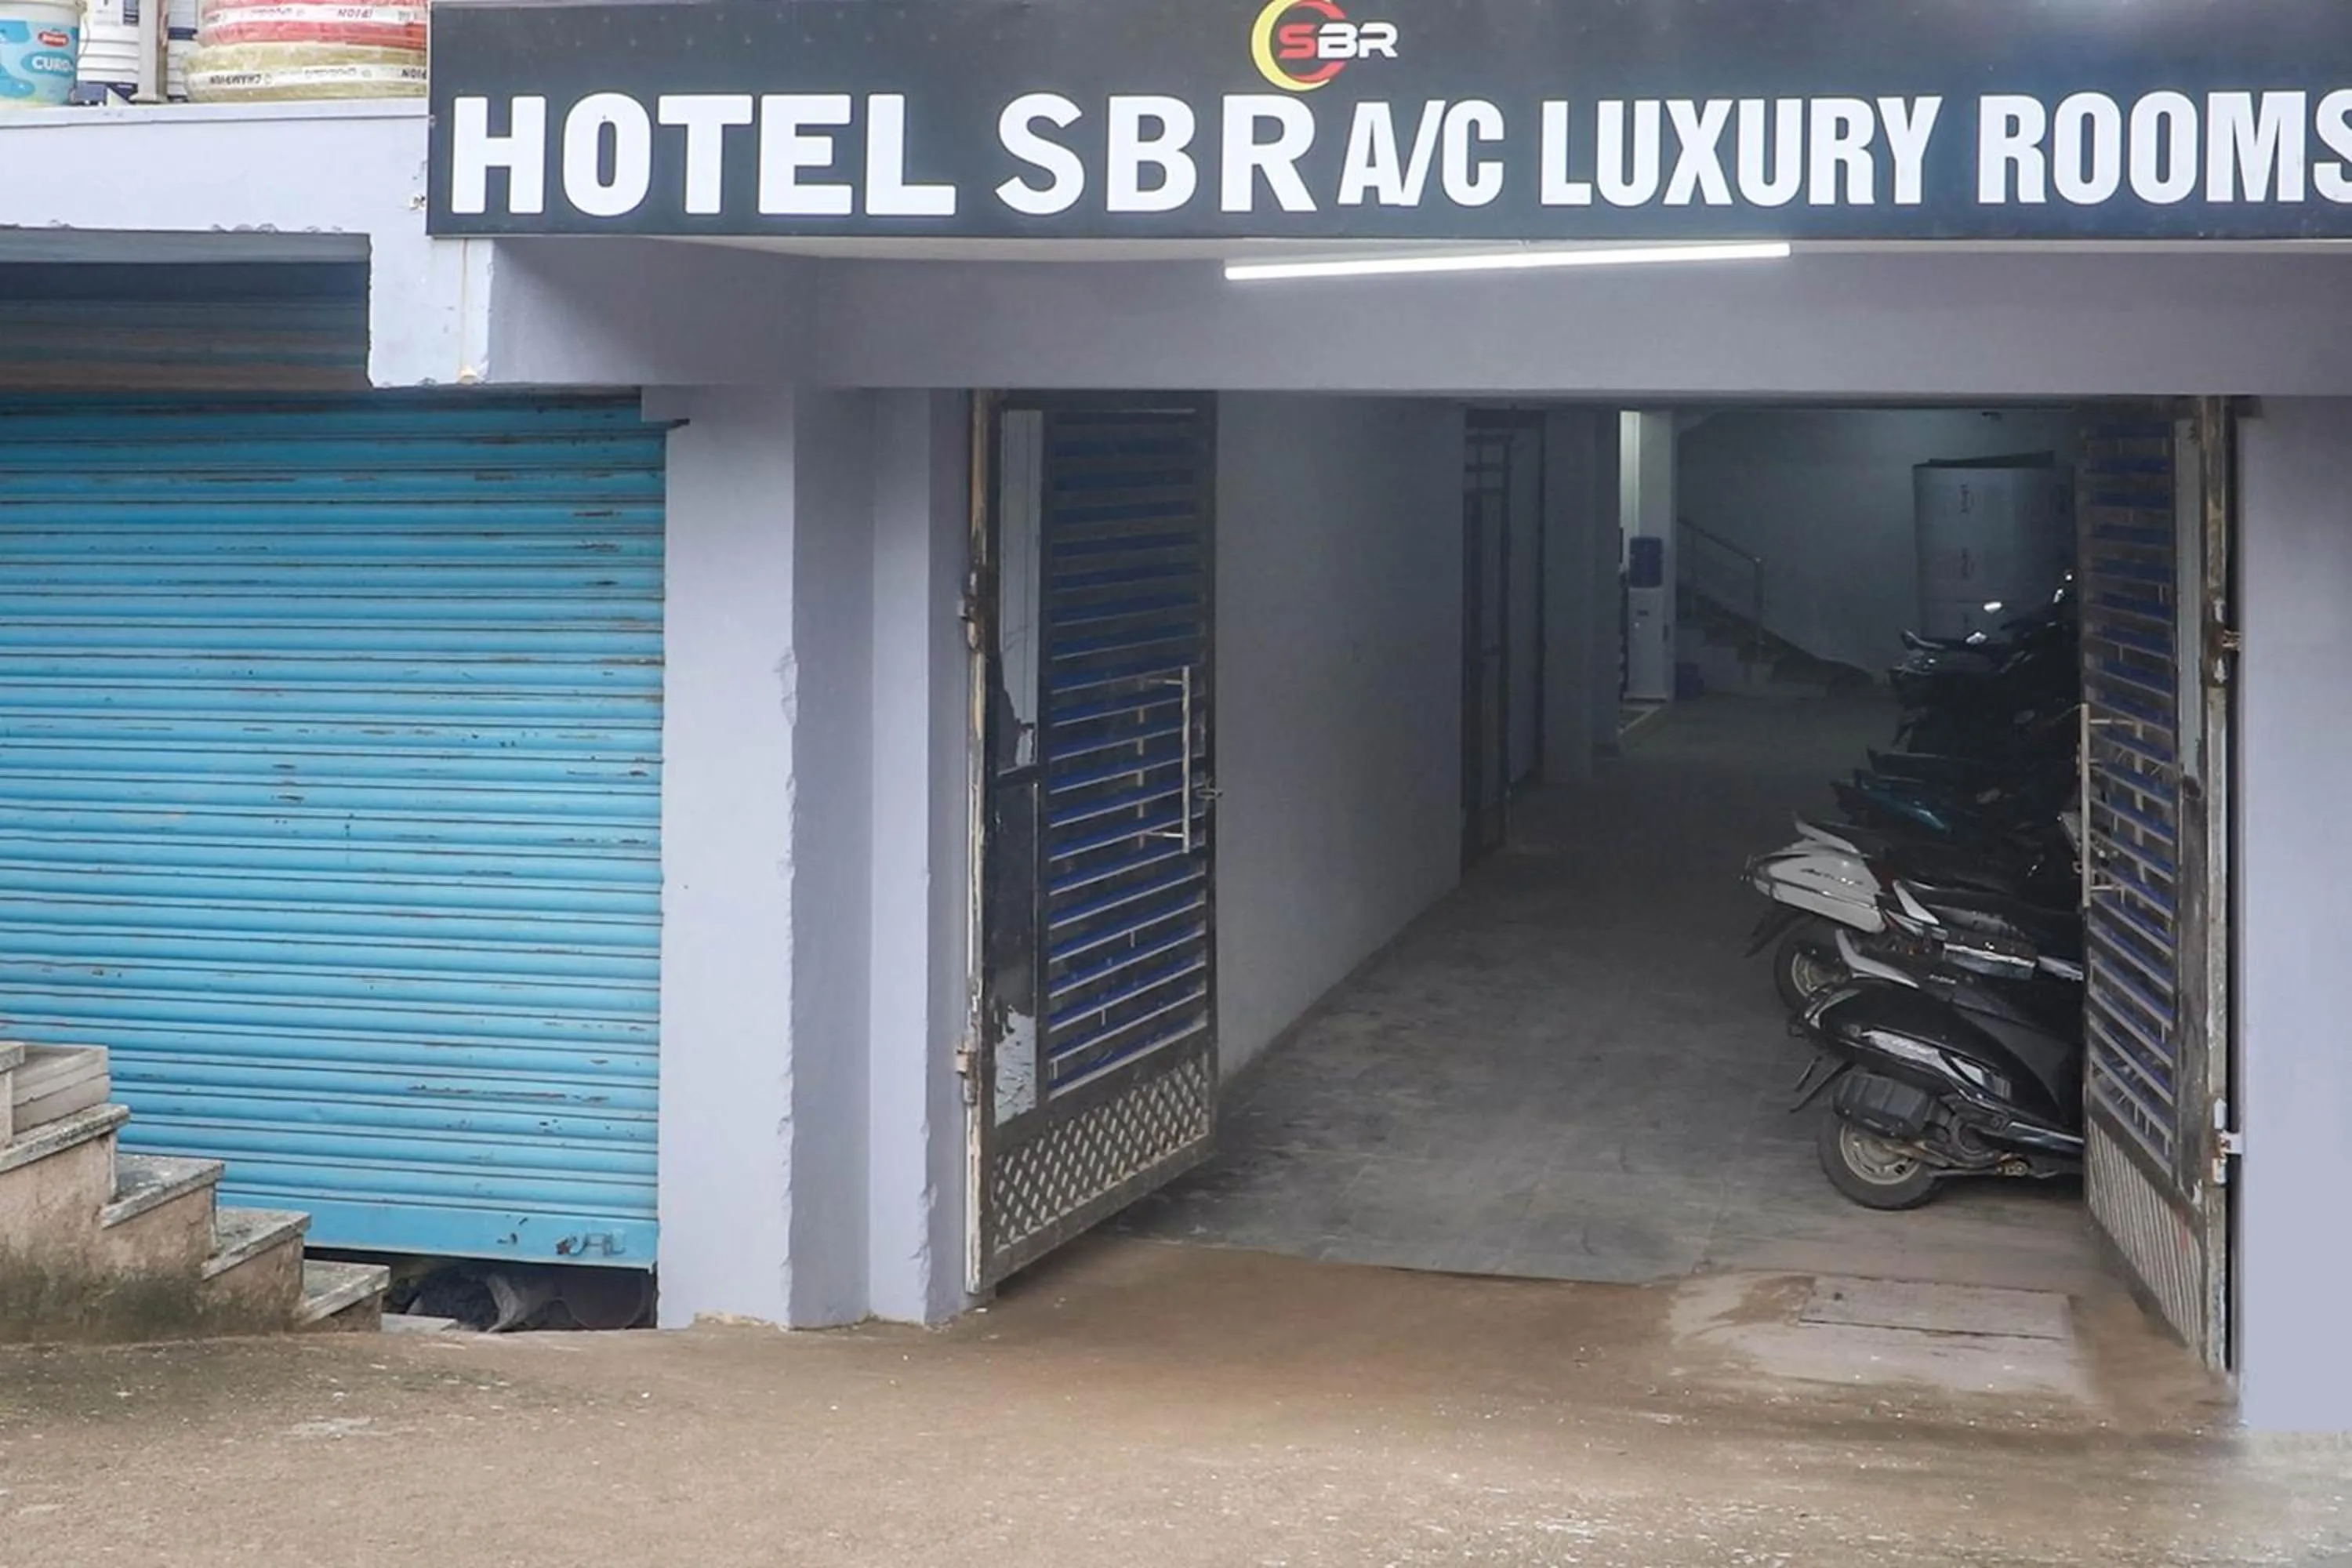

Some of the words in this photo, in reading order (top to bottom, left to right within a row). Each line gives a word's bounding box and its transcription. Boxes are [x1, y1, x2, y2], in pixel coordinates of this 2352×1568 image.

[1279, 22, 1398, 59] SBR
[452, 93, 956, 216] HOTEL
[995, 93, 1318, 215] SBR
[1338, 100, 1504, 206] A/C
[1541, 96, 1943, 207] LUXURY
[1978, 89, 2352, 205] ROOMS
